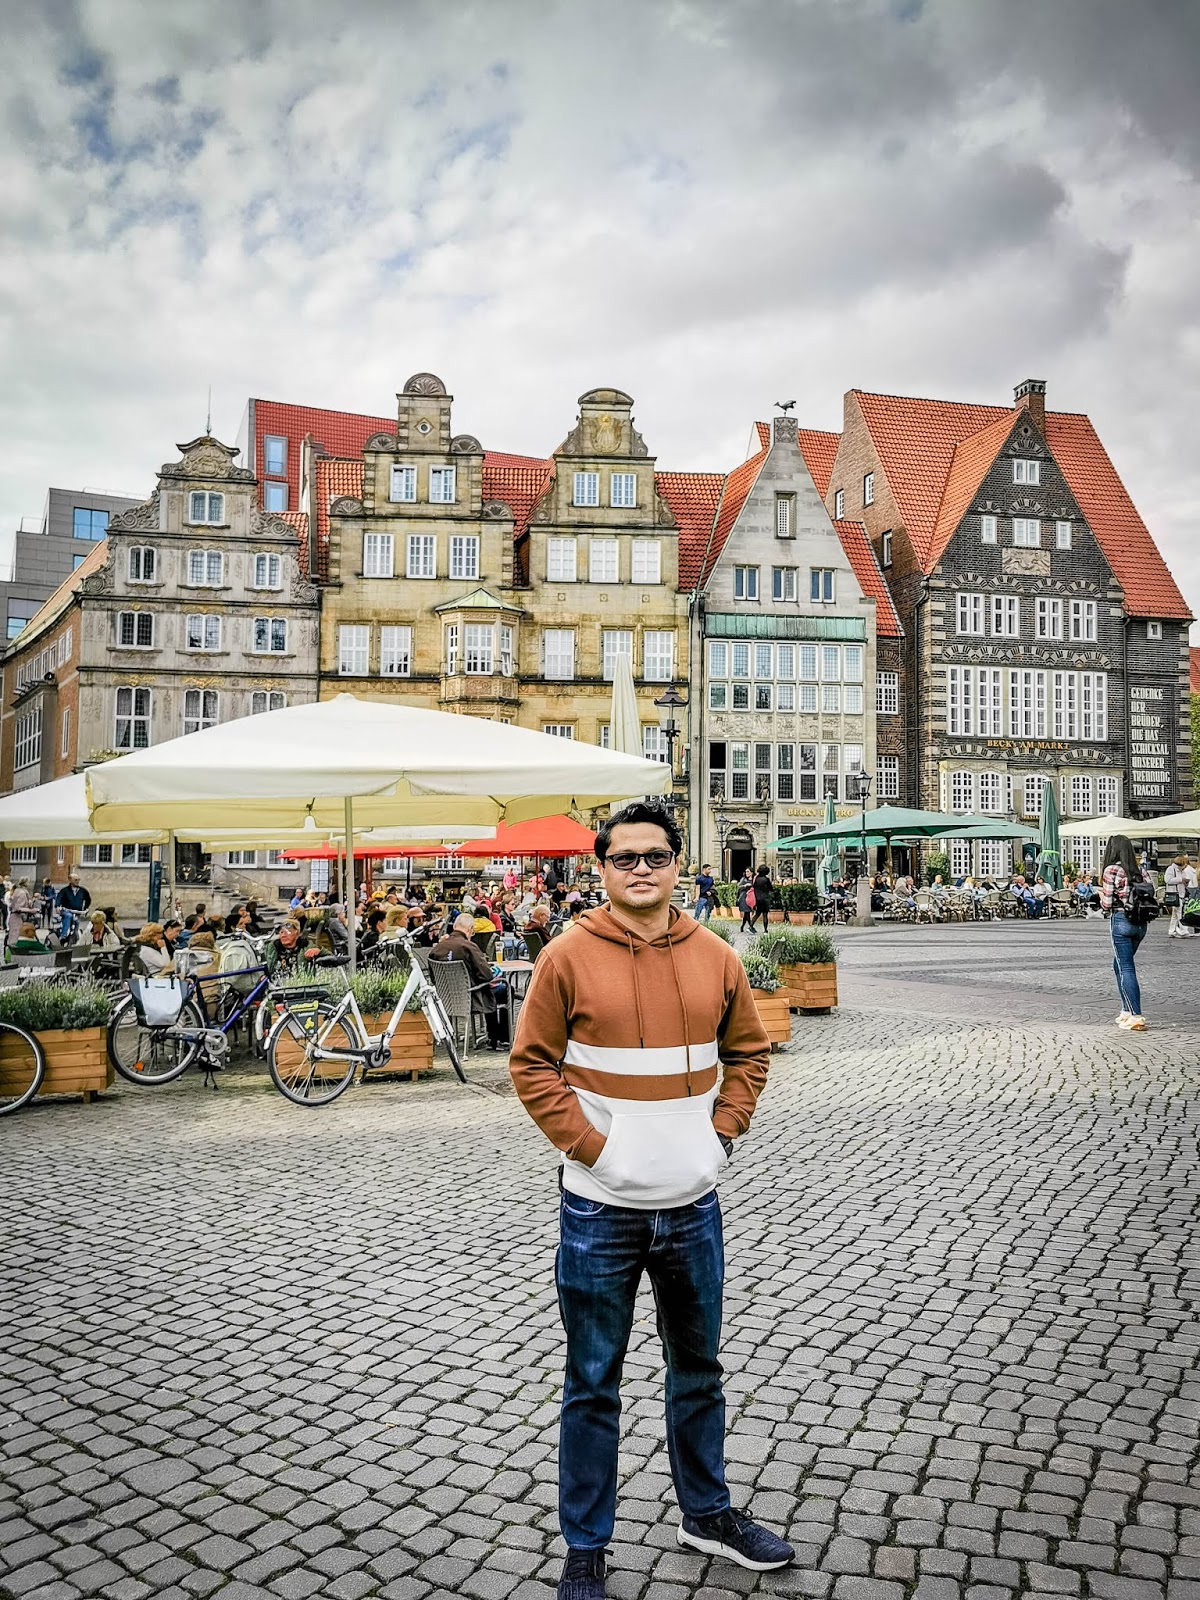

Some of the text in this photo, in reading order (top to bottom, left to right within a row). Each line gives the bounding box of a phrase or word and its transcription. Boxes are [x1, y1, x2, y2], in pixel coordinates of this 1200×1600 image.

[1131, 687, 1163, 700] GEDENKE
[1131, 701, 1146, 713] DER
[1132, 728, 1159, 741] DIE DAS
[1020, 741, 1034, 750] AM
[1037, 741, 1070, 750] MARKT
[1131, 742, 1170, 755] SCHICKSAL
[1132, 756, 1165, 769] UNSERER
[1132, 770, 1171, 783] TRENNUNG
